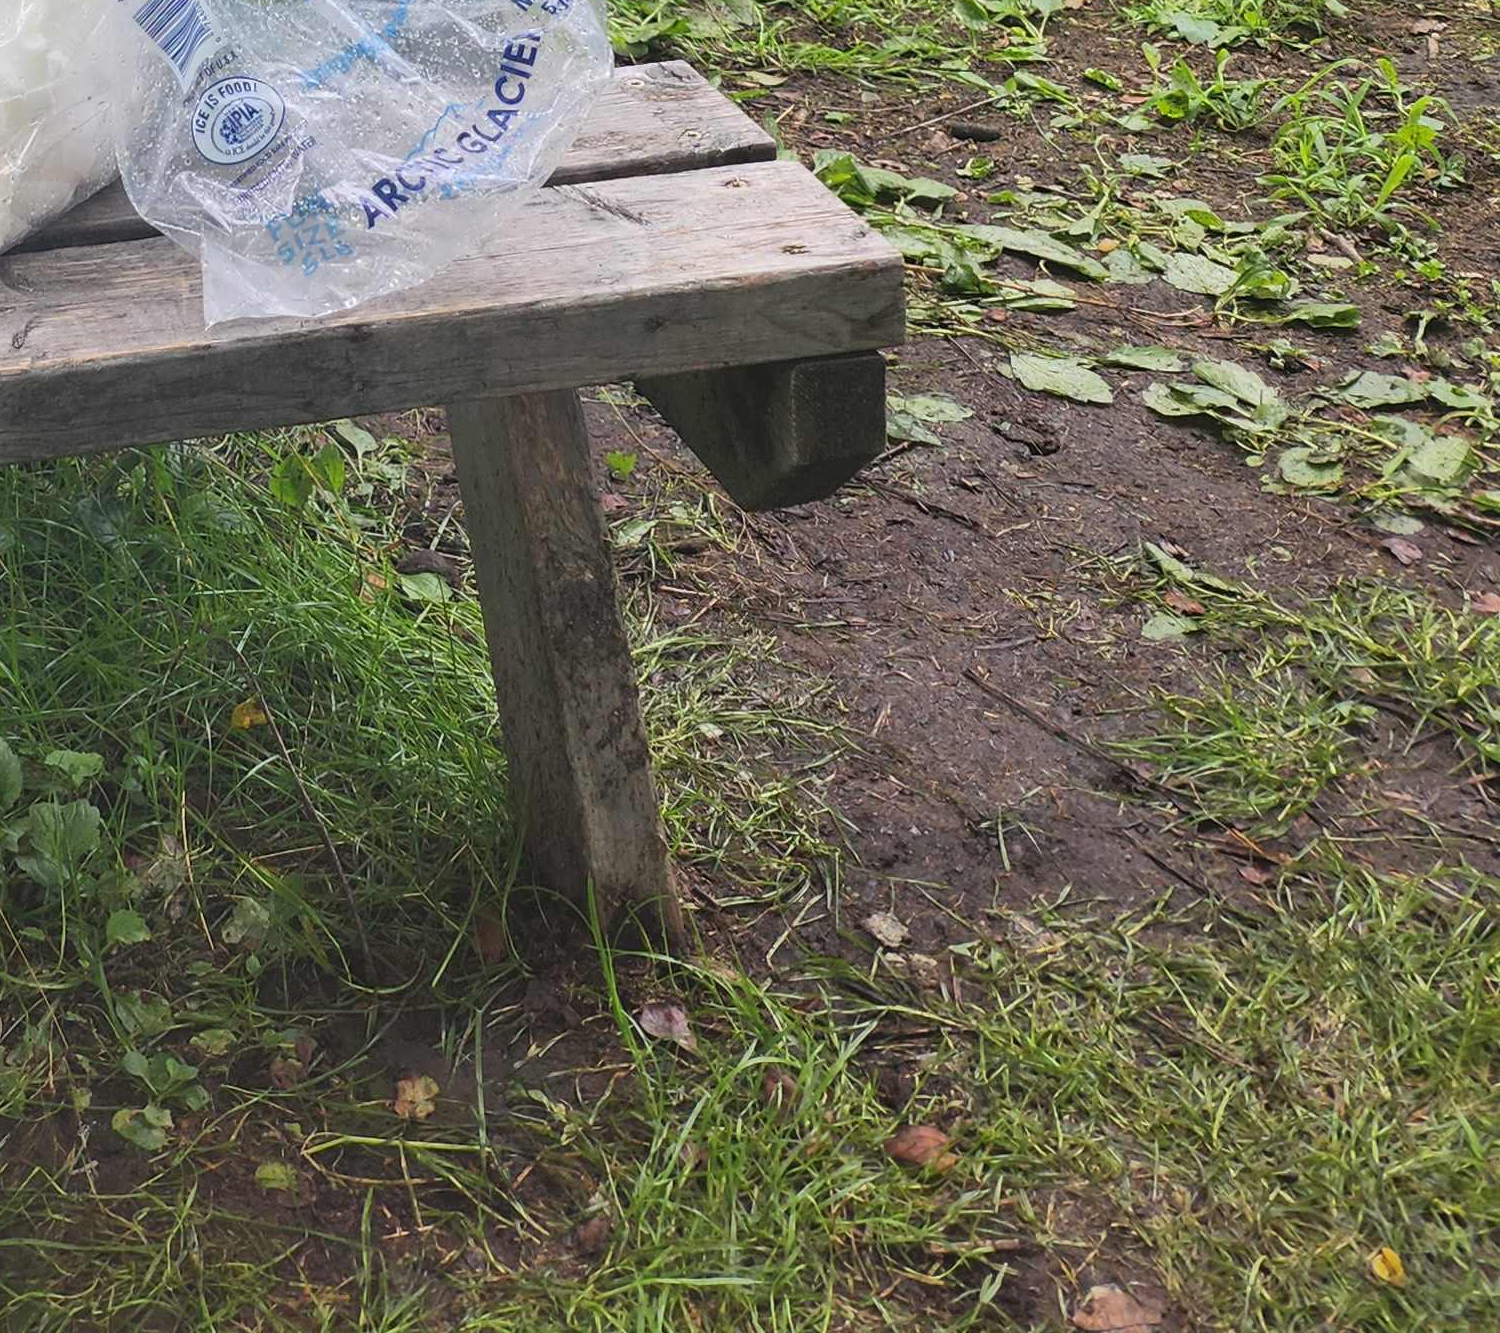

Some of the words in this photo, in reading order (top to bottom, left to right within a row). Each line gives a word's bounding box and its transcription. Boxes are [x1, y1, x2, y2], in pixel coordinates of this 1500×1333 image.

[195, 109, 210, 134] ICE
[204, 94, 220, 111] IS
[218, 81, 258, 99] FOOD!
